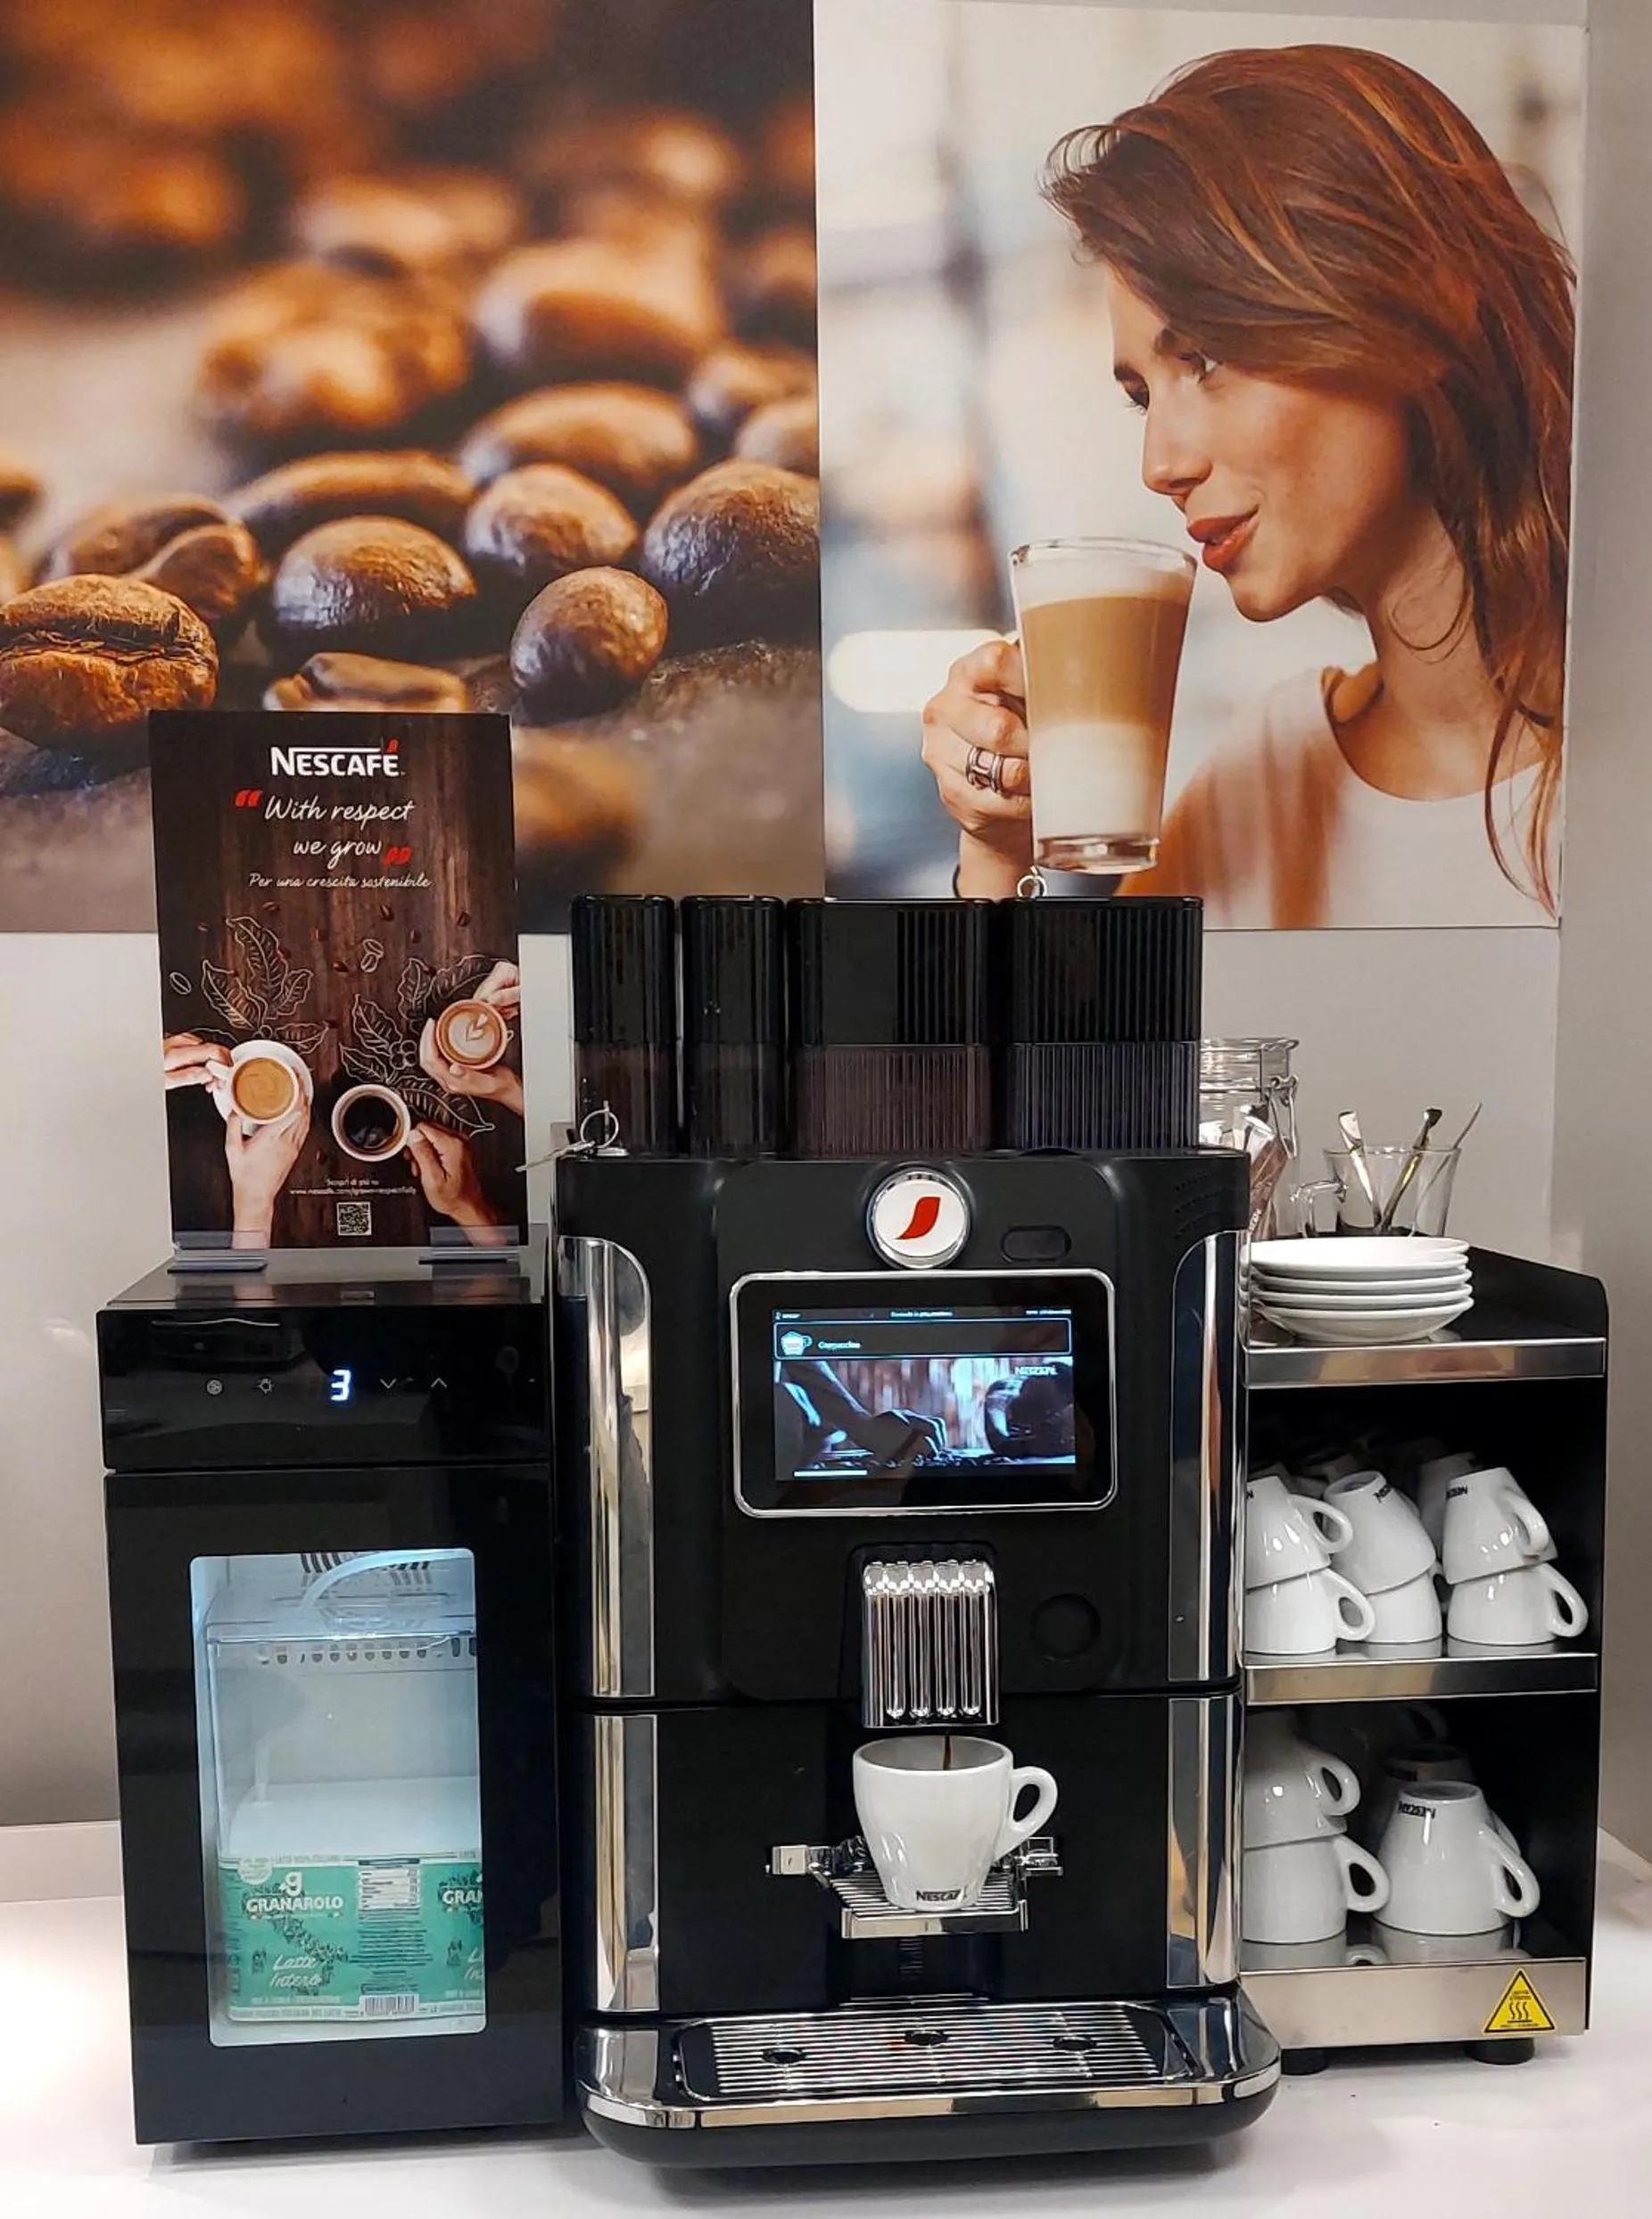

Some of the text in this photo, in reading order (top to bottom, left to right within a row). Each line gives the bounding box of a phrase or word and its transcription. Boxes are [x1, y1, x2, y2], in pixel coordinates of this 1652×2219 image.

[331, 800, 416, 831] respect
[293, 840, 326, 855] we
[249, 873, 272, 887] Per
[277, 878, 302, 887] una
[306, 875, 358, 887] crescita
[331, 1370, 351, 1401] 3
[245, 1896, 344, 1913] GRANAROLO
